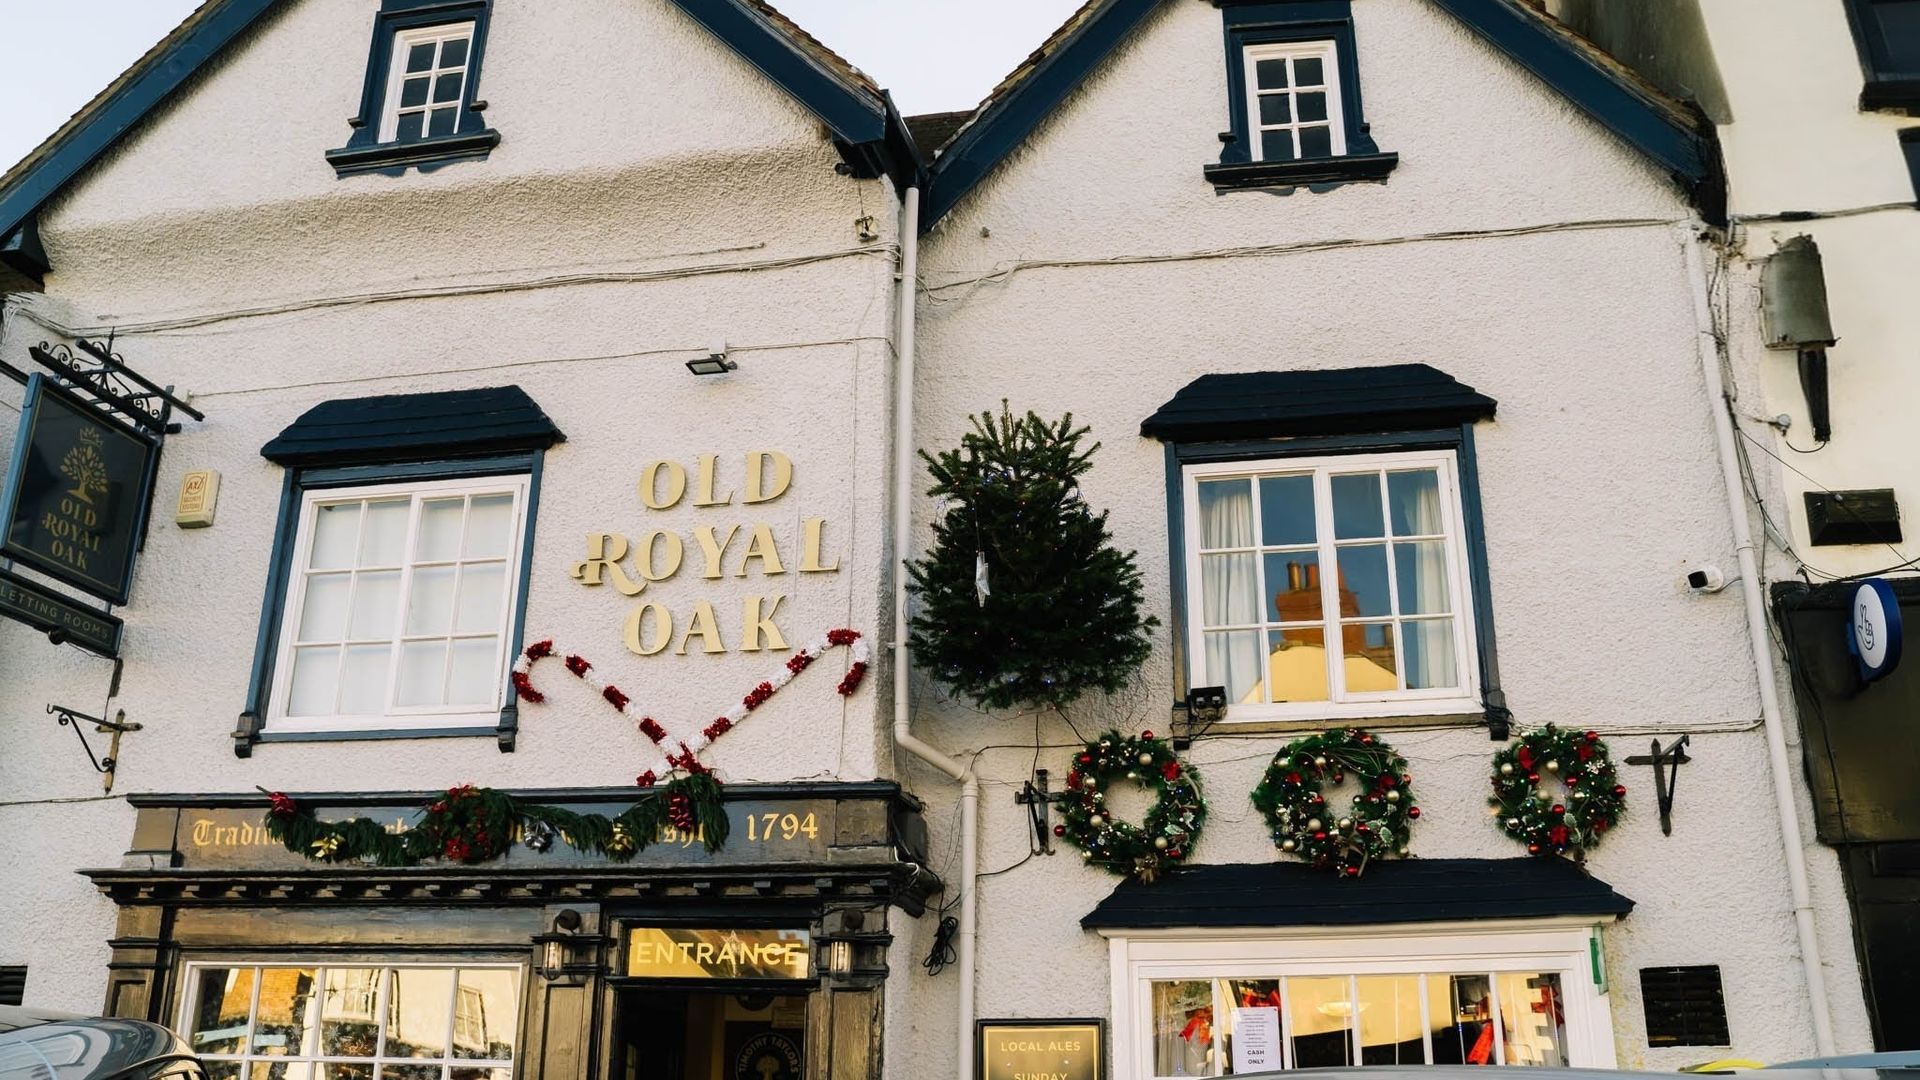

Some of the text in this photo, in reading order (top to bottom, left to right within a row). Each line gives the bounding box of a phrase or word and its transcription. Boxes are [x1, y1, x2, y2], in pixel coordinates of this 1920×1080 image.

[638, 450, 794, 510] OLD
[61, 499, 97, 527] OLD
[42, 513, 104, 551] ROYAL
[52, 539, 87, 570] OAK
[569, 517, 841, 596] ROYAL
[0, 585, 109, 639] LETTING ROOMS
[622, 594, 791, 656] OAK
[746, 812, 819, 841] 1794
[636, 942, 802, 966] ENTRANCE
[1001, 1041, 1081, 1052] LOCAL ALES
